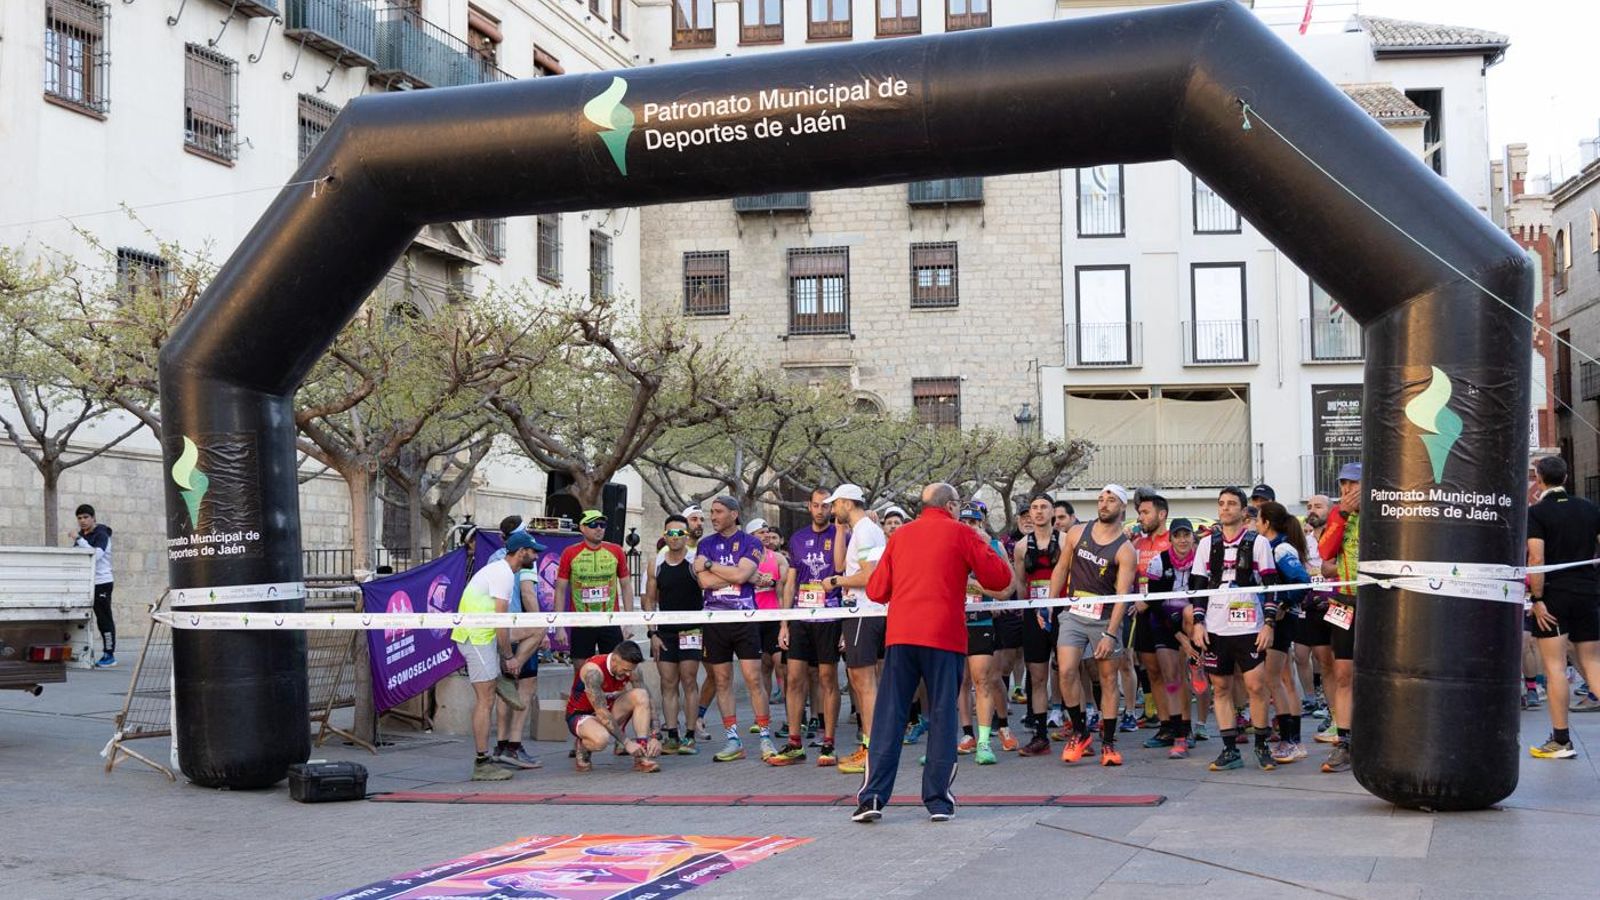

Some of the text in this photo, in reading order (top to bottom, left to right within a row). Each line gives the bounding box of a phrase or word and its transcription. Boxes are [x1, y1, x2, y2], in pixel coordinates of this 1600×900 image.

[643, 77, 908, 123] Patronato Municipal de
[645, 111, 846, 152] Deportes de Jaén
[1370, 489, 1512, 507] Patronato Municipal de
[1381, 504, 1498, 521] Deportes de Jaén
[190, 531, 242, 544] Municipal
[245, 530, 260, 541] de
[201, 545, 215, 556] de
[218, 543, 246, 556] Jaén
[1231, 611, 1246, 619] 121
